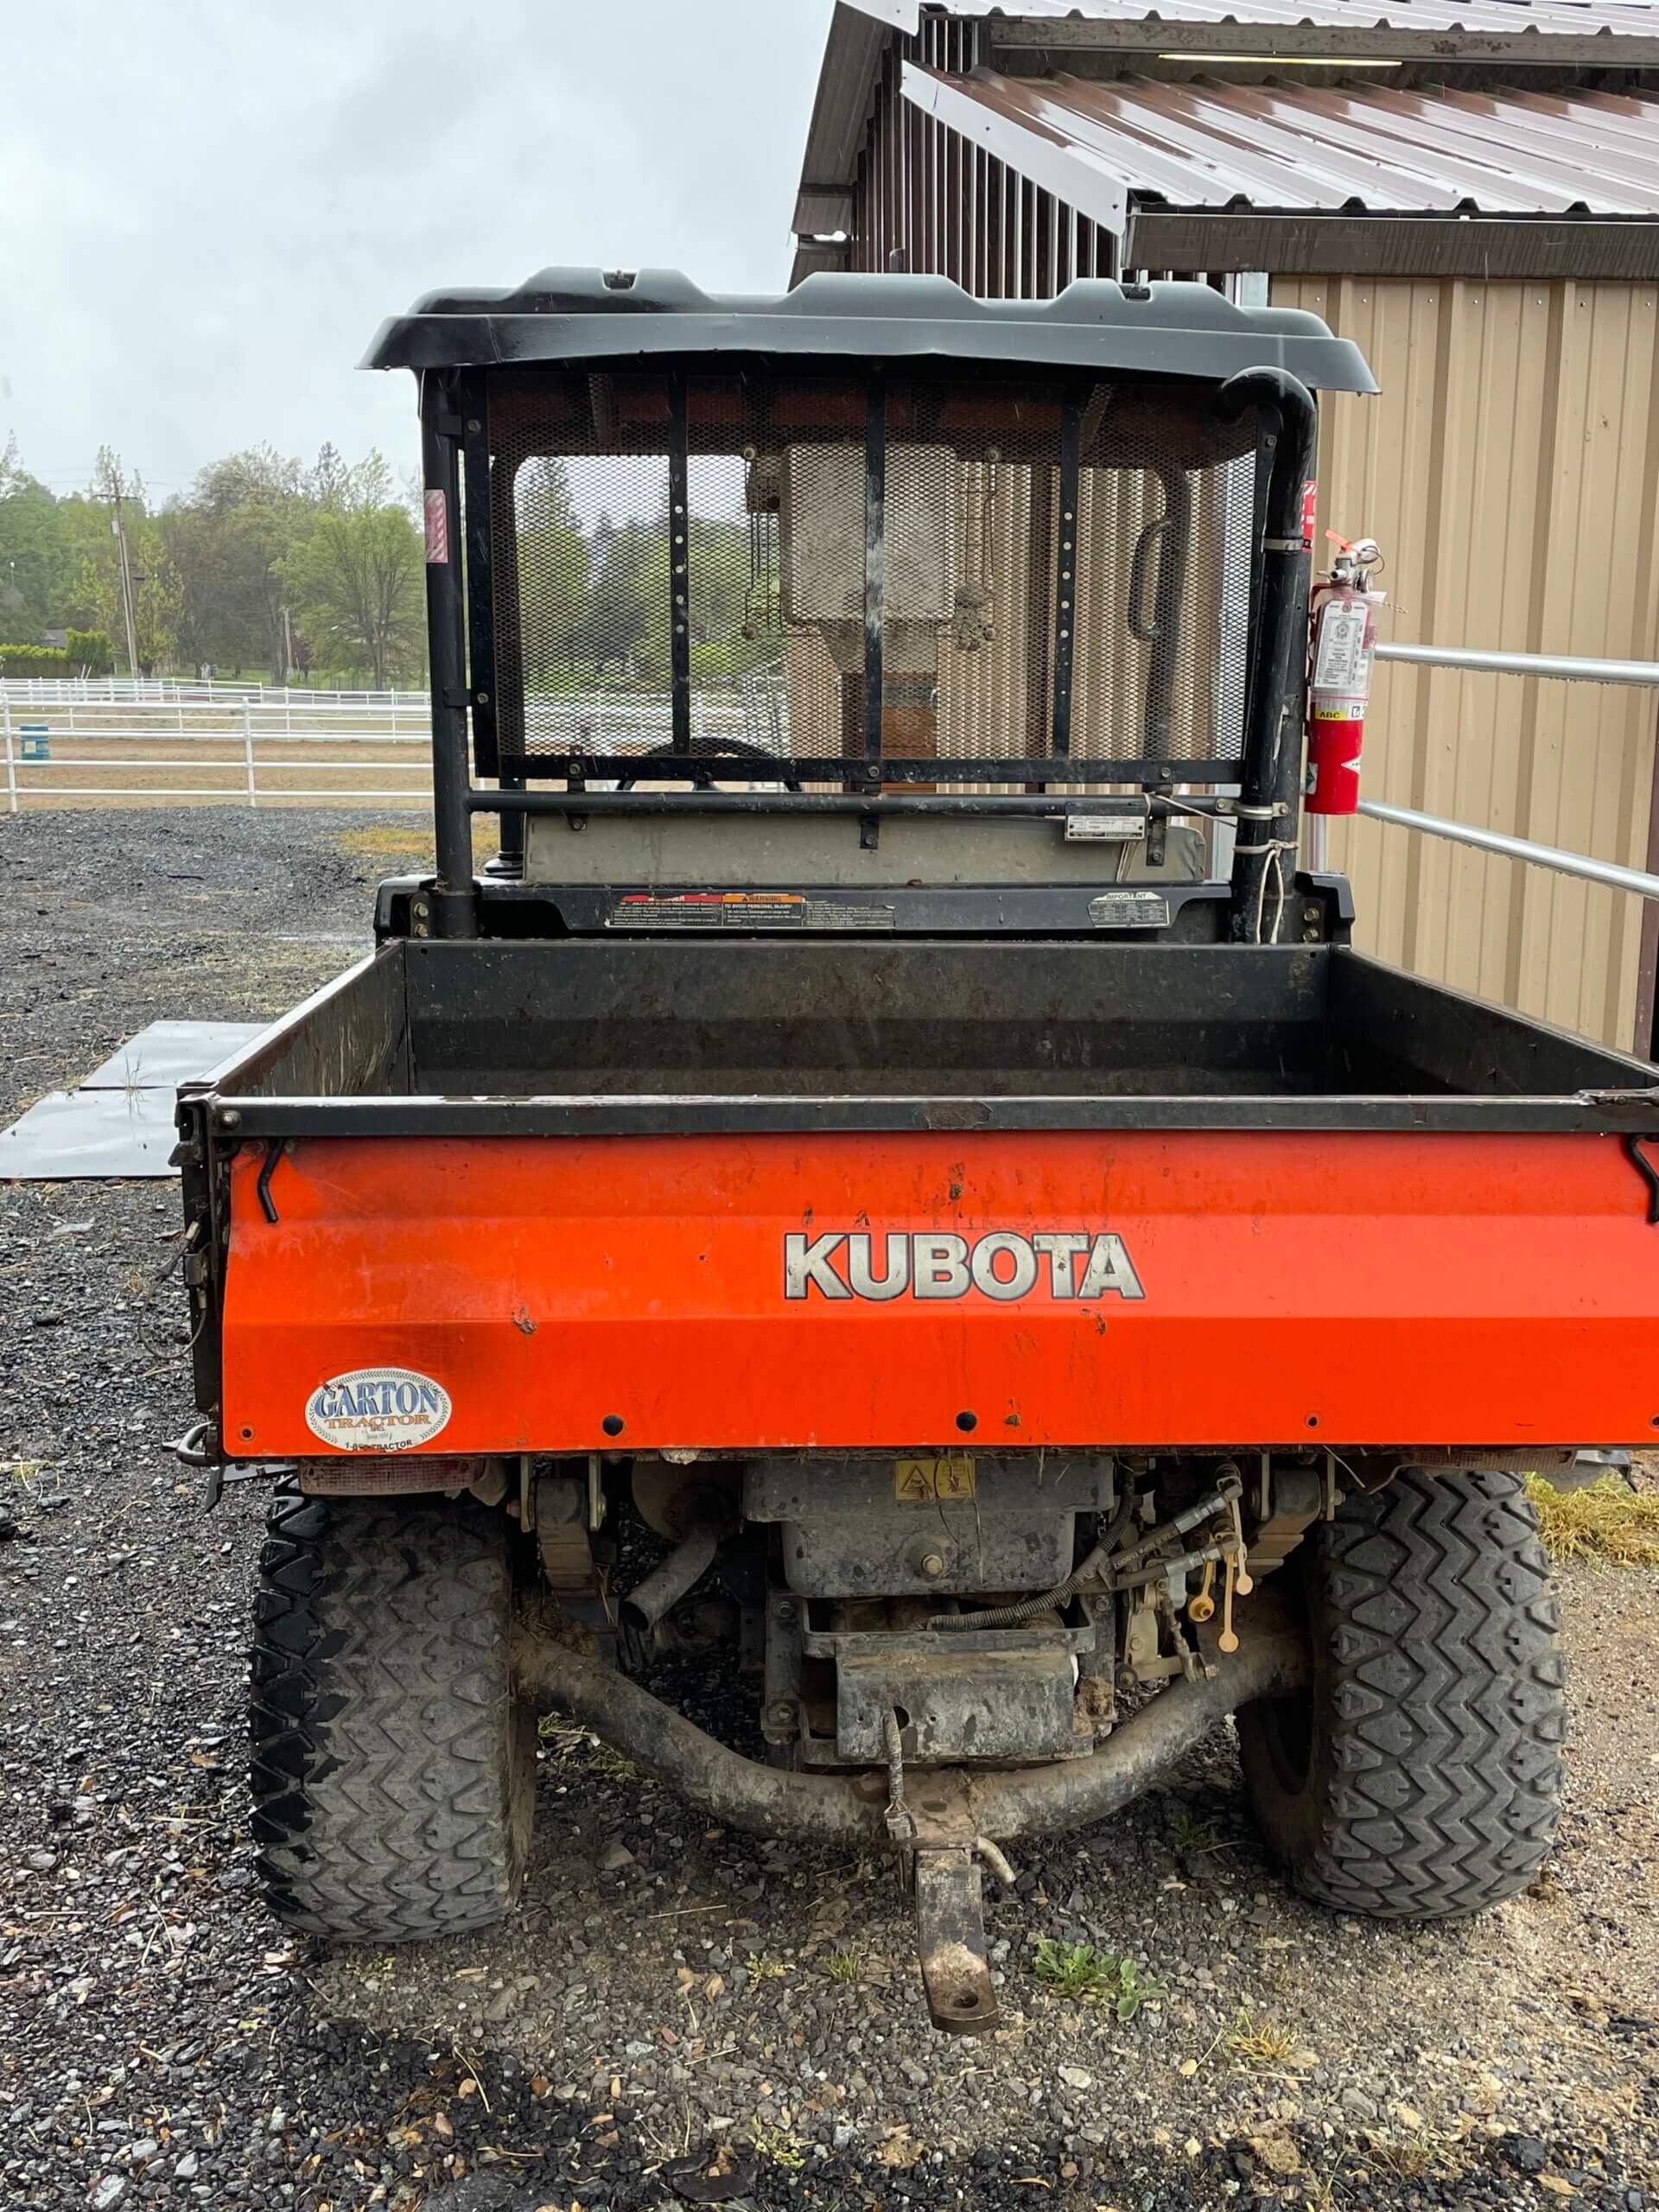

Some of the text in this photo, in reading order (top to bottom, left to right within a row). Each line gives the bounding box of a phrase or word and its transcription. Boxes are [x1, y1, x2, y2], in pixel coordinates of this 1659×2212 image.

[784, 1231, 1146, 1300] KUBOTA
[315, 1382, 438, 1418] GARTON
[325, 1414, 431, 1428] TRACTOR
